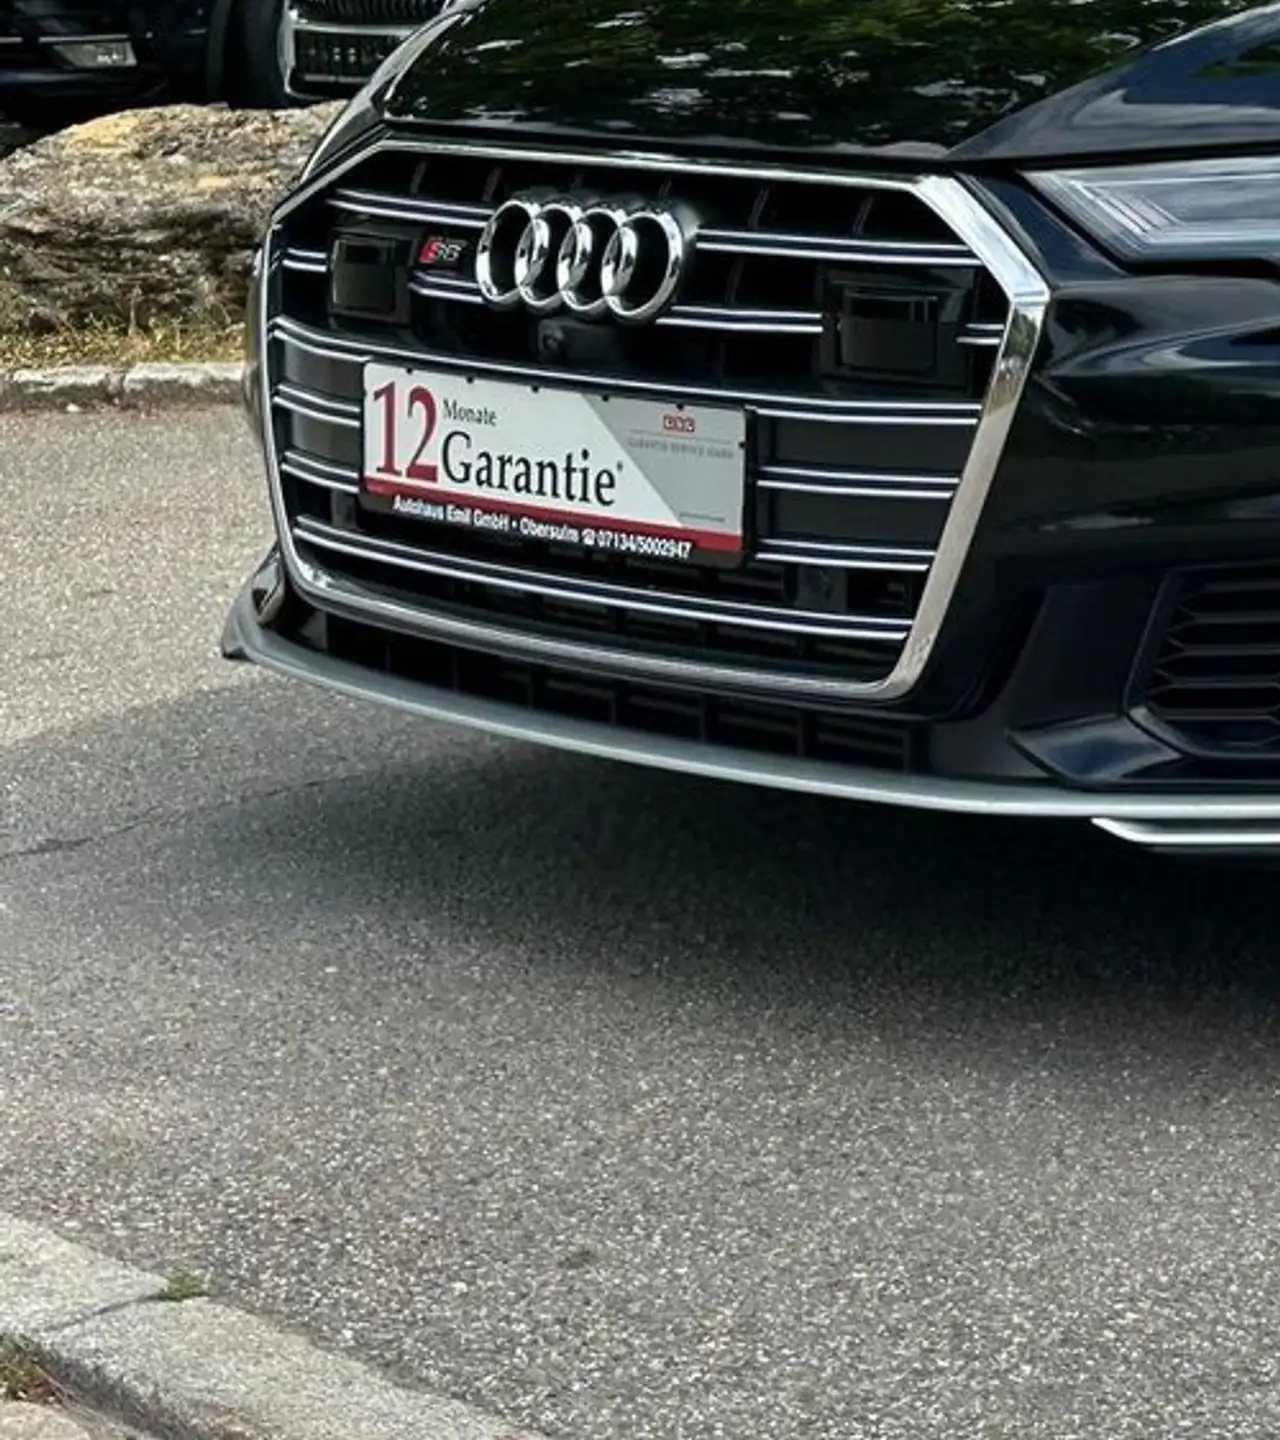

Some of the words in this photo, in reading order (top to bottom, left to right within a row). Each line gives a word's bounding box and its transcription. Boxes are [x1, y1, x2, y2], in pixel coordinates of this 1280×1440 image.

[373, 380, 438, 484] 12
[443, 397, 498, 427] Monate
[392, 493, 444, 521] Autohaus
[446, 503, 471, 524] Emil
[473, 507, 510, 532] GmbH
